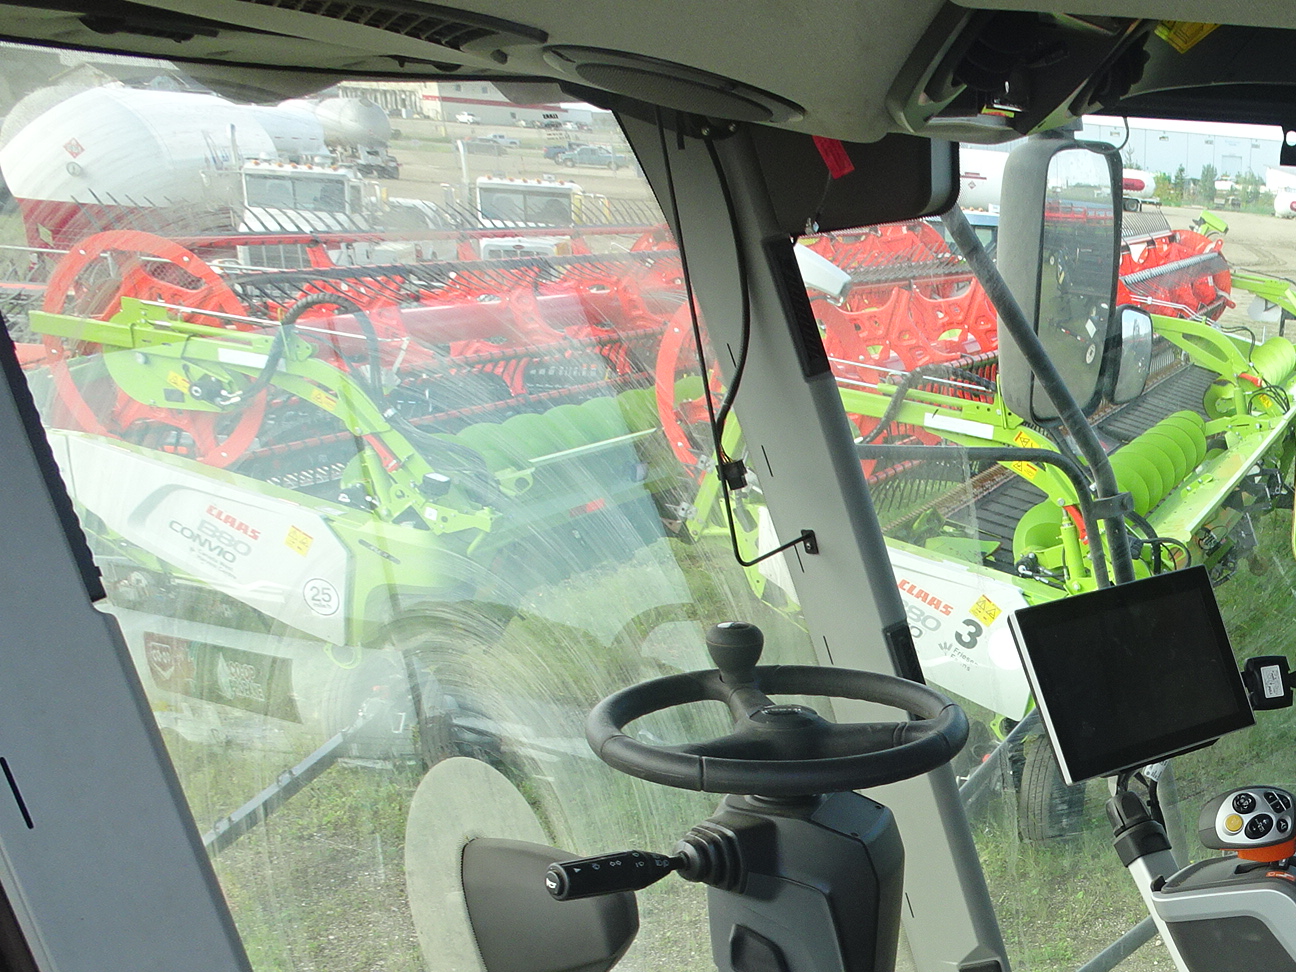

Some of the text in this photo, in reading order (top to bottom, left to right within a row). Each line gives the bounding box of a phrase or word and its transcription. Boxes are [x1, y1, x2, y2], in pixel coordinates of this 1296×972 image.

[206, 504, 261, 541] CLAAS
[168, 520, 236, 563] CONVIO
[309, 586, 332, 603] 25
[897, 579, 954, 616] CLAAS
[903, 600, 942, 631] 80
[954, 618, 983, 649] 3
